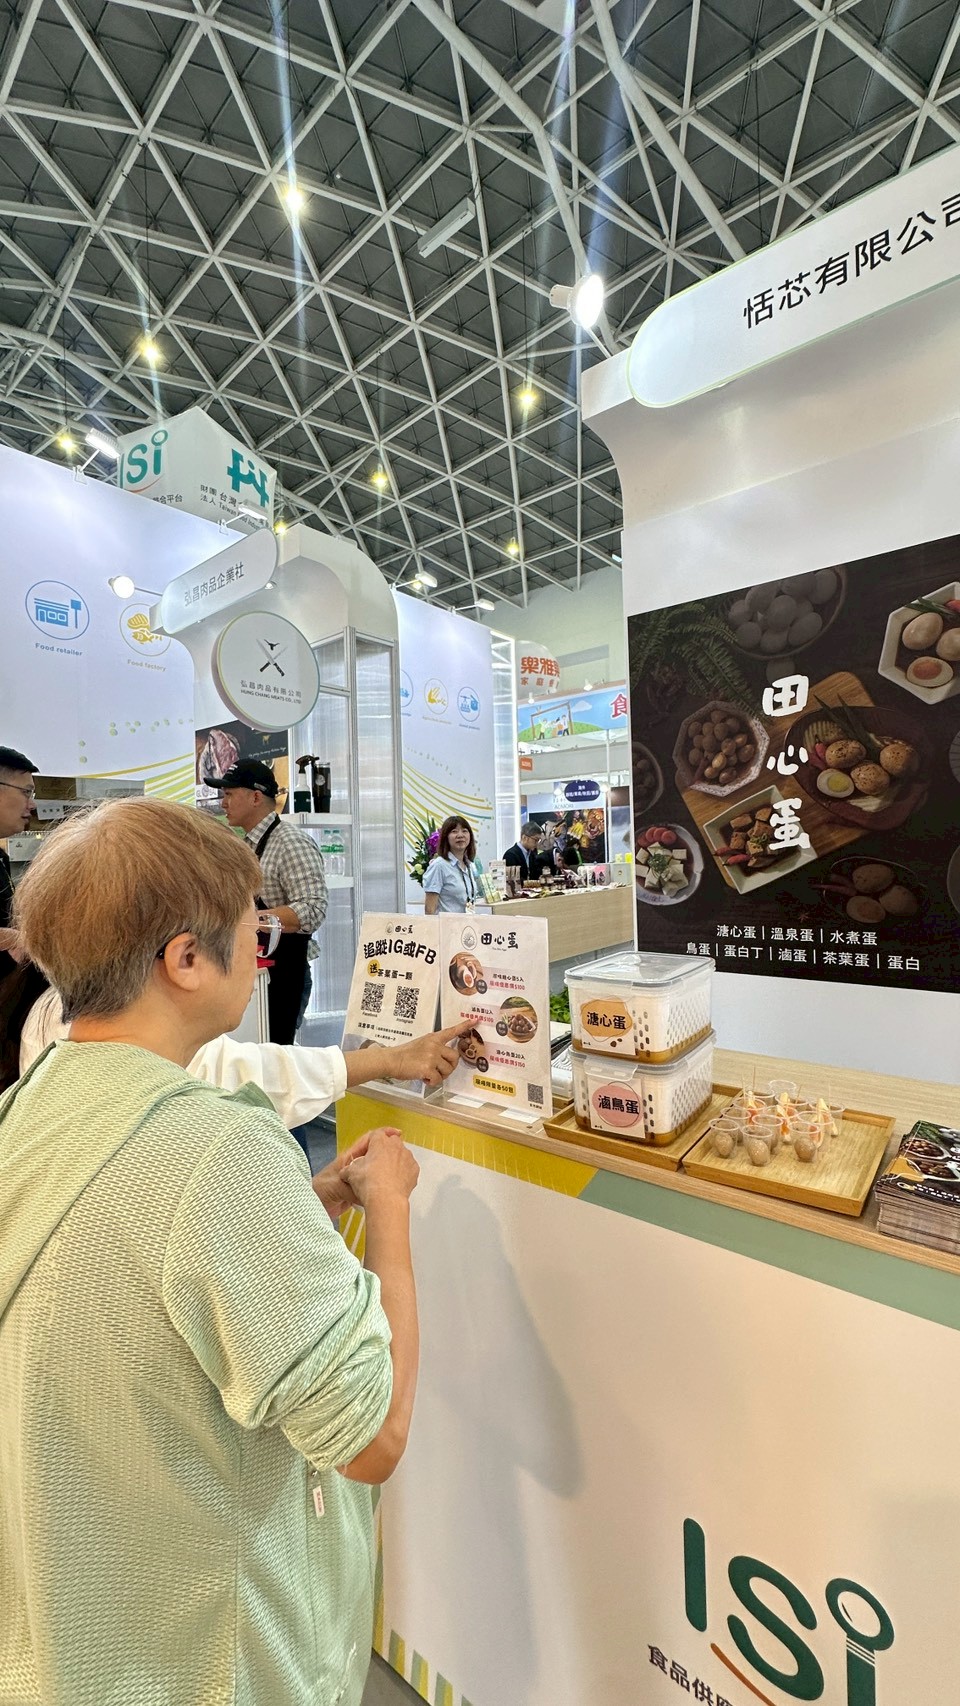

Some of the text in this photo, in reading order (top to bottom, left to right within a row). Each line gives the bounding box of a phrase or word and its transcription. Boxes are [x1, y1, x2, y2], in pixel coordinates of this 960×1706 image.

[184, 561, 245, 607] 弘昌肉品企業社
[35, 642, 83, 657] Food retailer
[127, 659, 167, 672] Food factory
[240, 679, 302, 698] 弘昌肉品有限公司
[254, 691, 270, 699] CHANG
[610, 693, 627, 719] 食
[762, 674, 811, 850] 田心蛋
[394, 924, 413, 935] 田心蛋
[770, 927, 814, 943] 溫泉蛋
[829, 929, 878, 946] 水煮蛋
[480, 931, 519, 950] 田心蛋
[723, 944, 763, 959] 蛋白丁
[822, 950, 870, 967] 茶葉蛋
[887, 954, 920, 971] 蛋白
[586, 1011, 626, 1030] 溏心蛋
[598, 1095, 640, 1115] 滷鳥蛋
